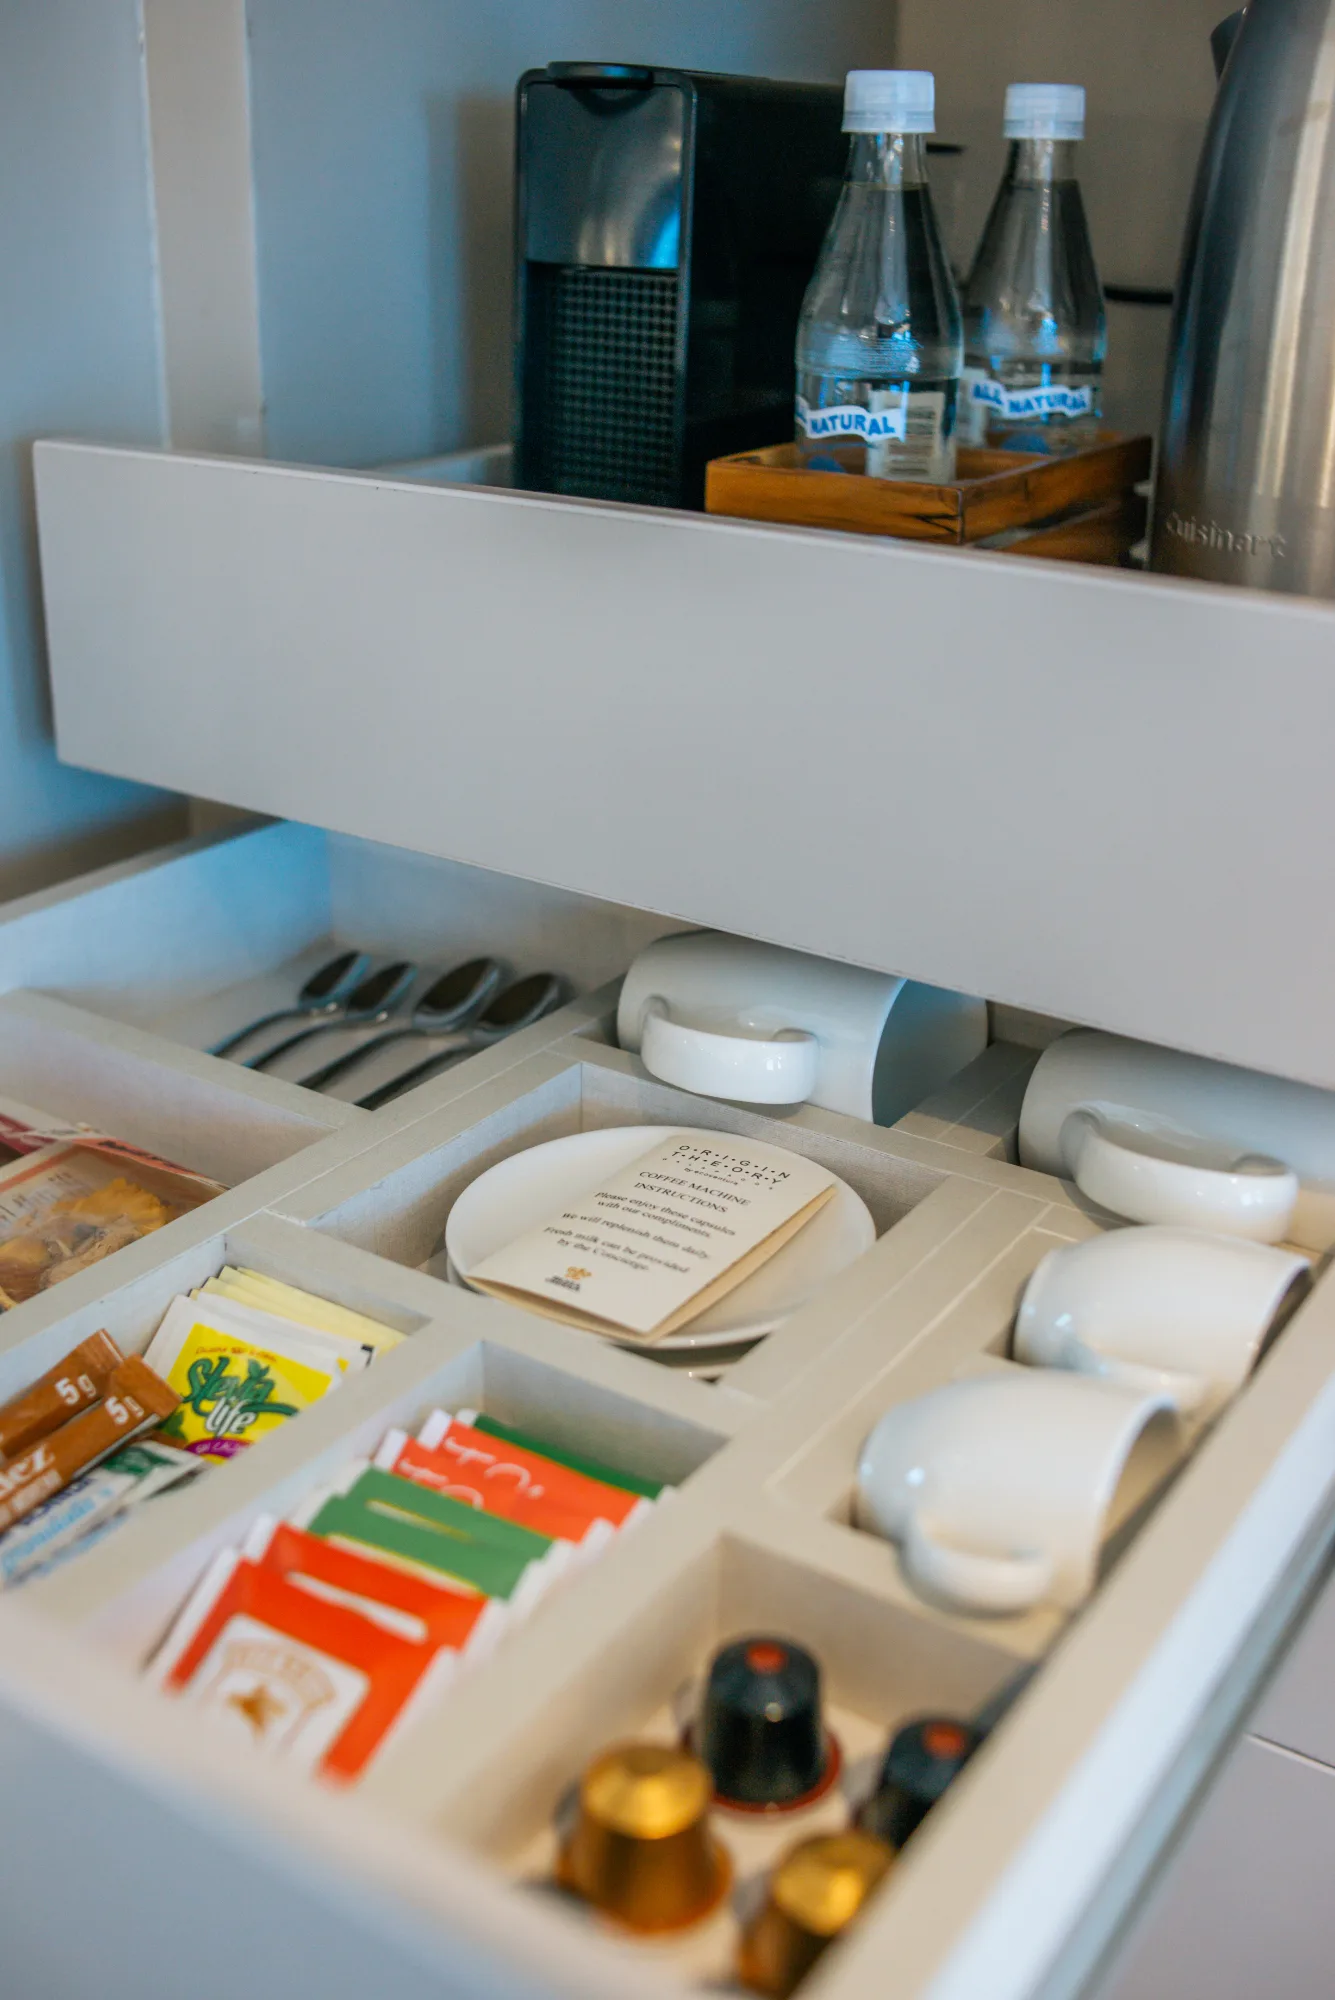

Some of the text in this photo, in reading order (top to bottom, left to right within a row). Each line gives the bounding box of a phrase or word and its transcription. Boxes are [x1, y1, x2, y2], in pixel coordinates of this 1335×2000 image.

[1008, 392, 1088, 413] NATURAL
[810, 414, 896, 436] NATURAL
[634, 1182, 728, 1213] INSTRUCTIONS
[639, 1171, 751, 1206] COFFEE MACHINE
[594, 1191, 736, 1236] Please enjoy these capsules
[597, 1200, 620, 1209] with
[622, 1206, 641, 1214] our
[557, 1238, 570, 1247] by
[573, 1242, 592, 1252] the
[580, 1215, 601, 1224] will
[601, 1219, 650, 1238] replenish
[652, 1234, 680, 1249] them
[543, 1226, 690, 1273] Fresh milk can be provided
[182, 1357, 295, 1417] Stevia
[205, 1395, 259, 1438] life
